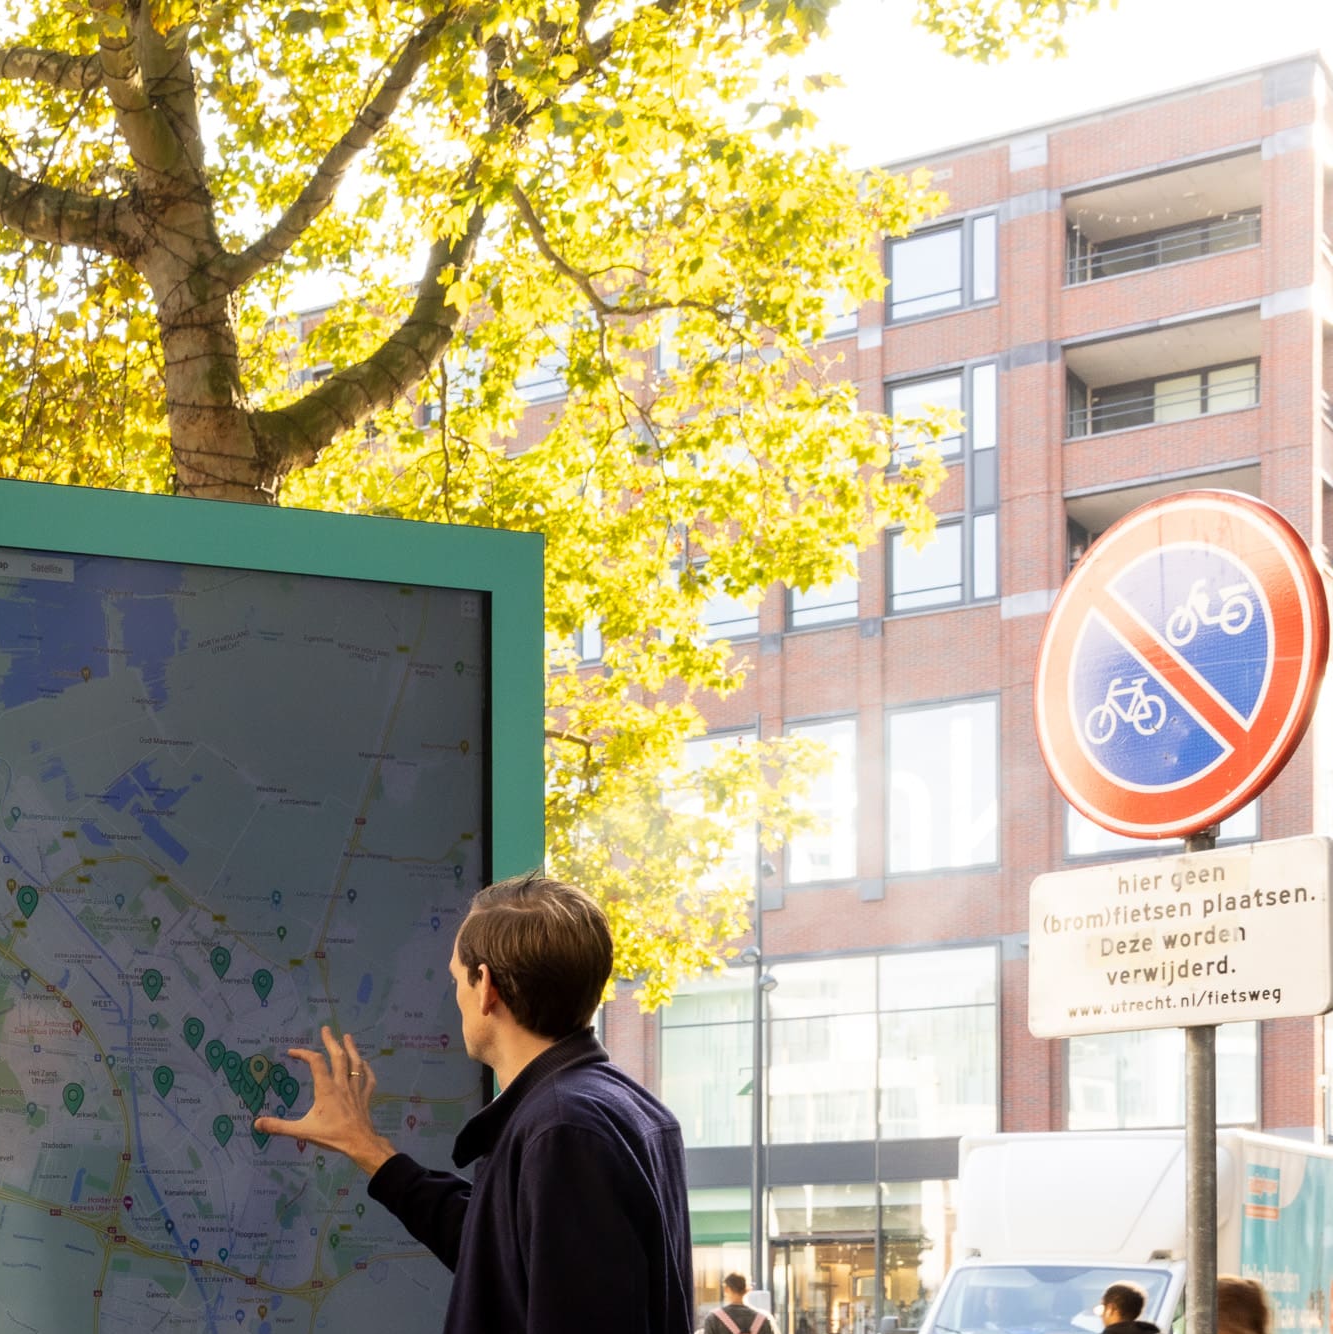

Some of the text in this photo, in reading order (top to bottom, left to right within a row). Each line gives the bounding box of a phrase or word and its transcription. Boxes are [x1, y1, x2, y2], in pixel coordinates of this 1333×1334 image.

[30, 563, 64, 575] Satellite
[1117, 865, 1226, 896] hier geen
[1042, 885, 1317, 935] (brom)fietsen plaatsen.
[1100, 925, 1246, 957] Deze worden
[1106, 956, 1237, 988] verwijderd.
[91, 999, 113, 1008] WEST
[1067, 986, 1283, 1019] www.utrecht.nl/fietsweg
